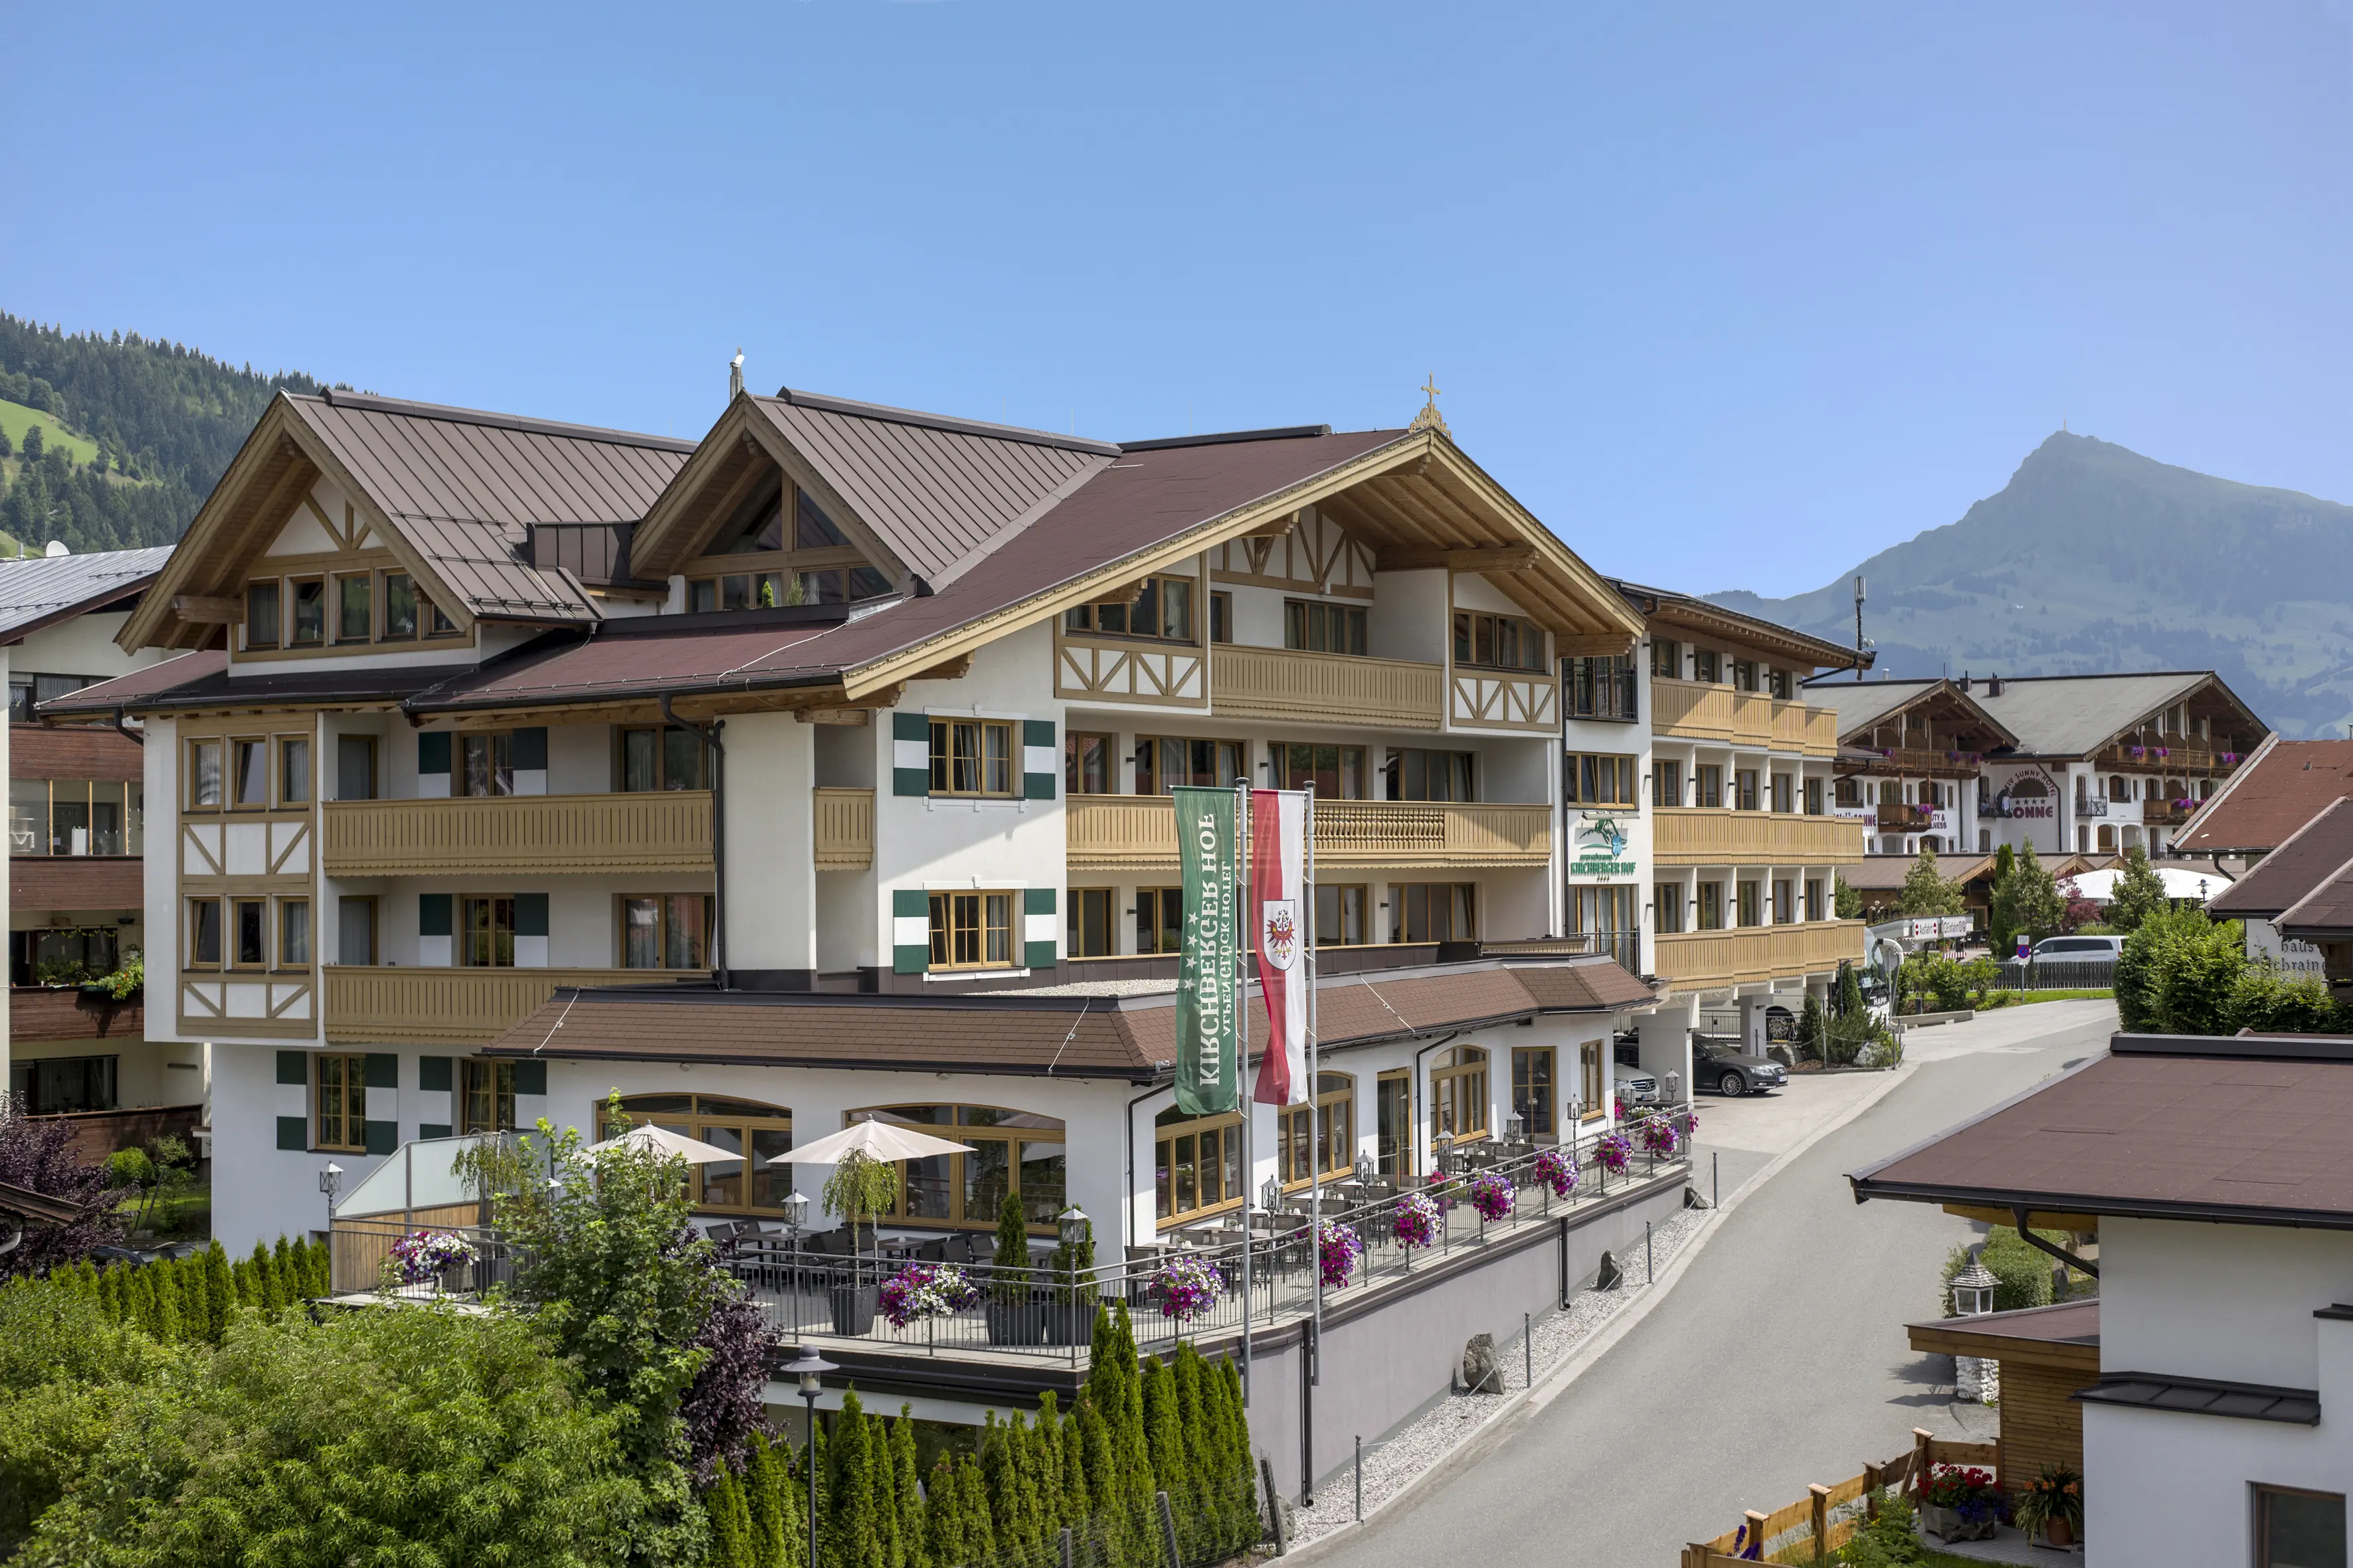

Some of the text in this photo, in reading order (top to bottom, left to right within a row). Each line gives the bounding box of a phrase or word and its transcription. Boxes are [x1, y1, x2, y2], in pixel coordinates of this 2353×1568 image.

[2015, 769, 2040, 780] SUNNY
[2041, 775, 2056, 797] HOTEL
[2012, 806, 2053, 819] ONNE
[1570, 862, 1636, 875] KIRCHBERGER HOF
[1919, 924, 1933, 935] Ausfahrt
[1946, 922, 1959, 933] Einfahrt
